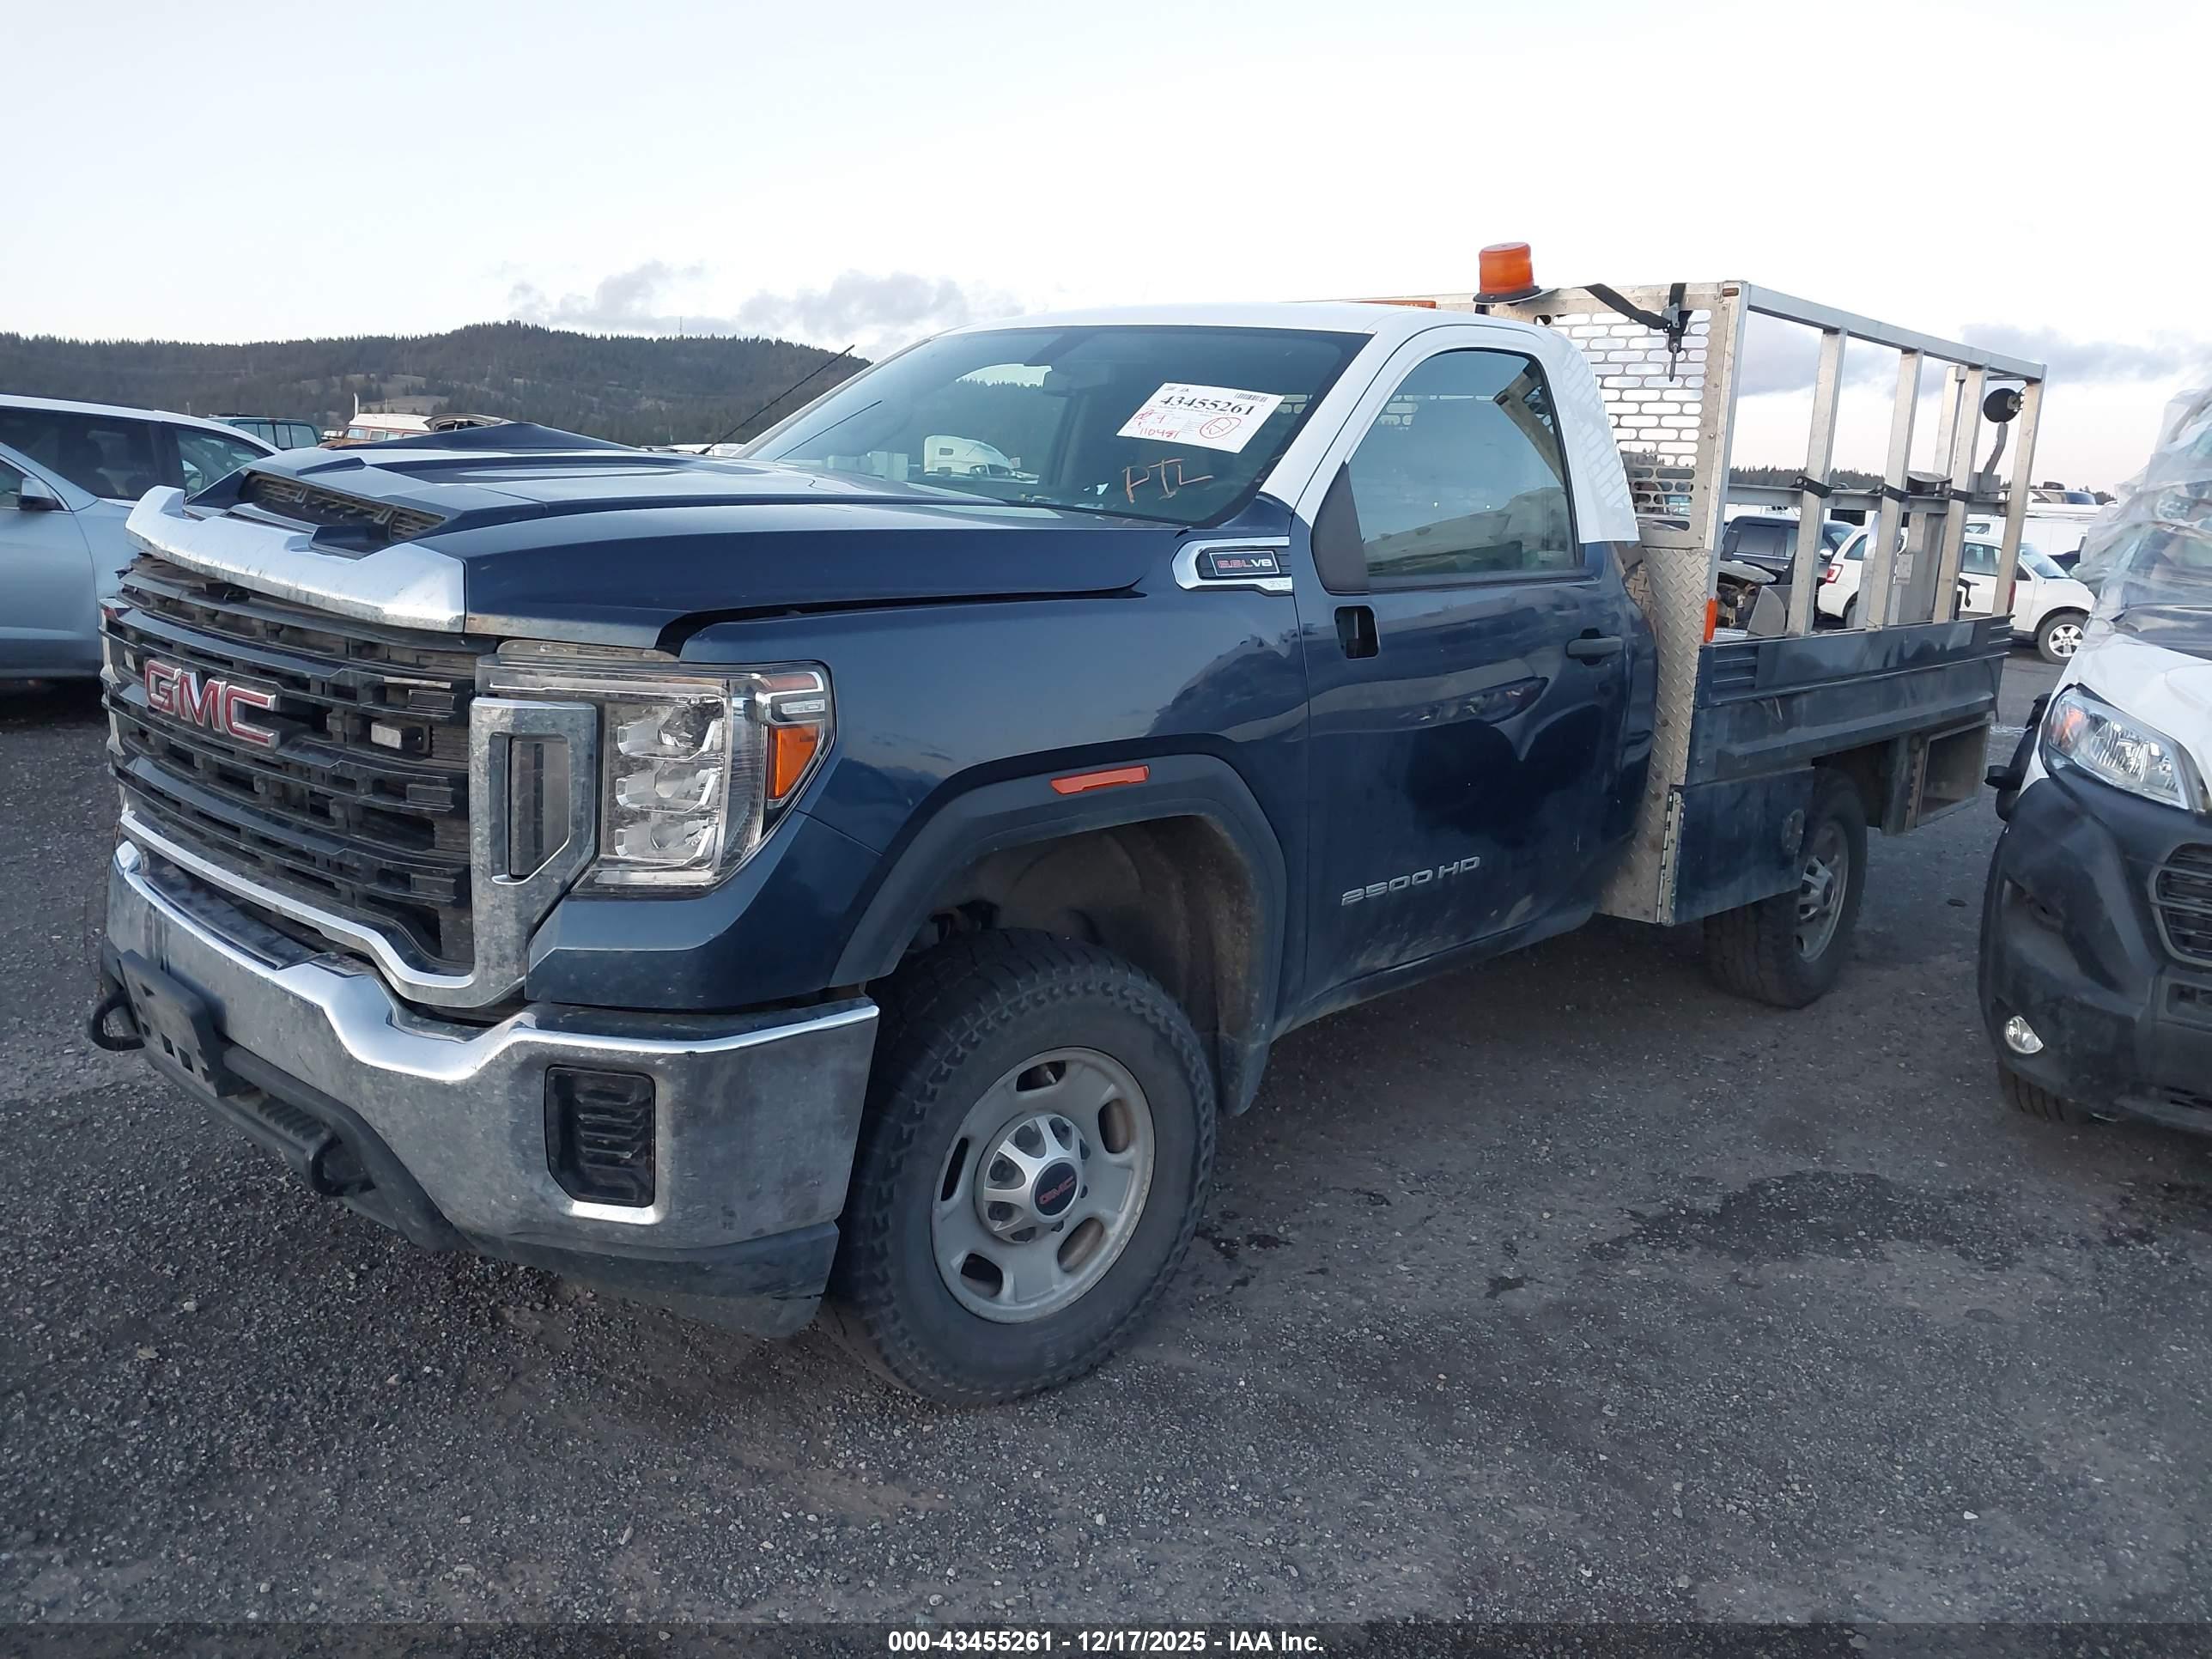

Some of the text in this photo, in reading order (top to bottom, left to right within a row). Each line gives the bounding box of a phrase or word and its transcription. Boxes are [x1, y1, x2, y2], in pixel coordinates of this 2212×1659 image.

[1160, 395, 1256, 416] 43455261
[144, 659, 281, 750] GMC
[1340, 855, 1481, 907] 2500 HD
[1038, 1175, 1075, 1206] GMC
